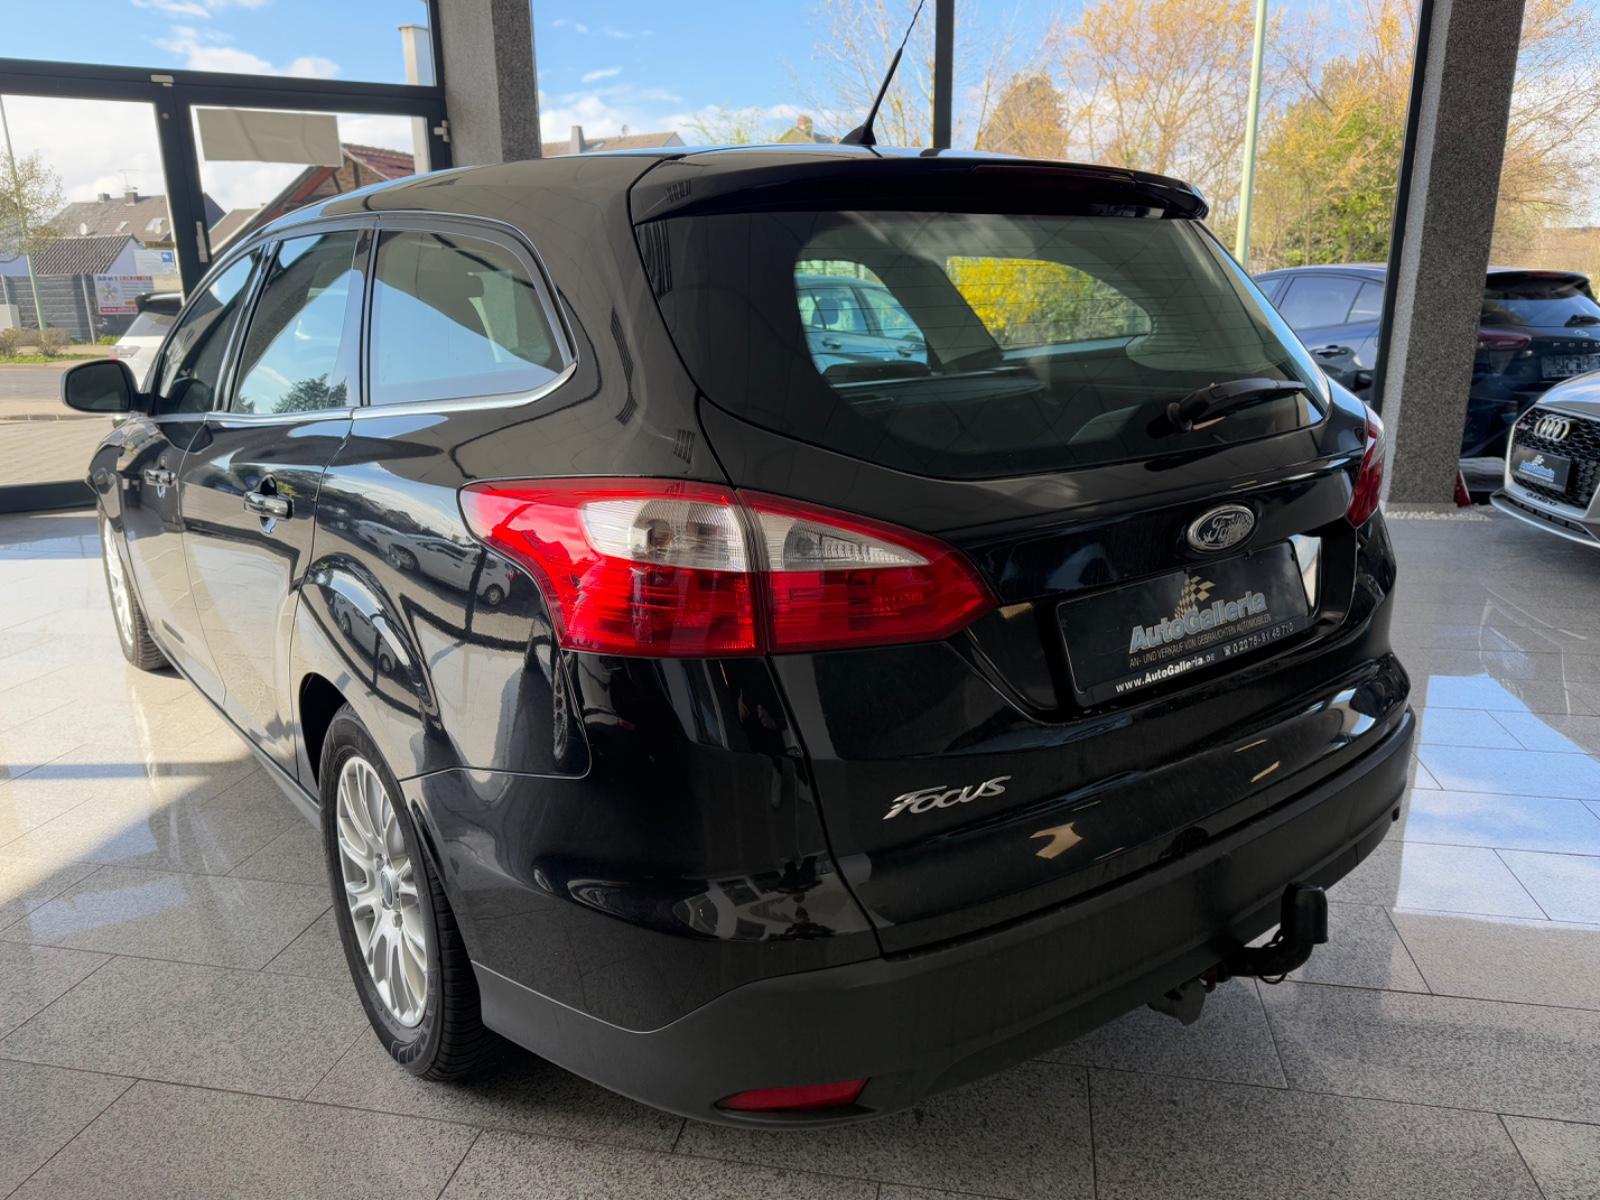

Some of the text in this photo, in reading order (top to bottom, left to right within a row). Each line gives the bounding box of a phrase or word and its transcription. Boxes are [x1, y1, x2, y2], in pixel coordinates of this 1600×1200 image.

[1129, 591, 1268, 654] AutoGalleria
[1143, 649, 1157, 664] UND
[1157, 642, 1183, 658] VERKAUF
[1184, 636, 1197, 649] VON
